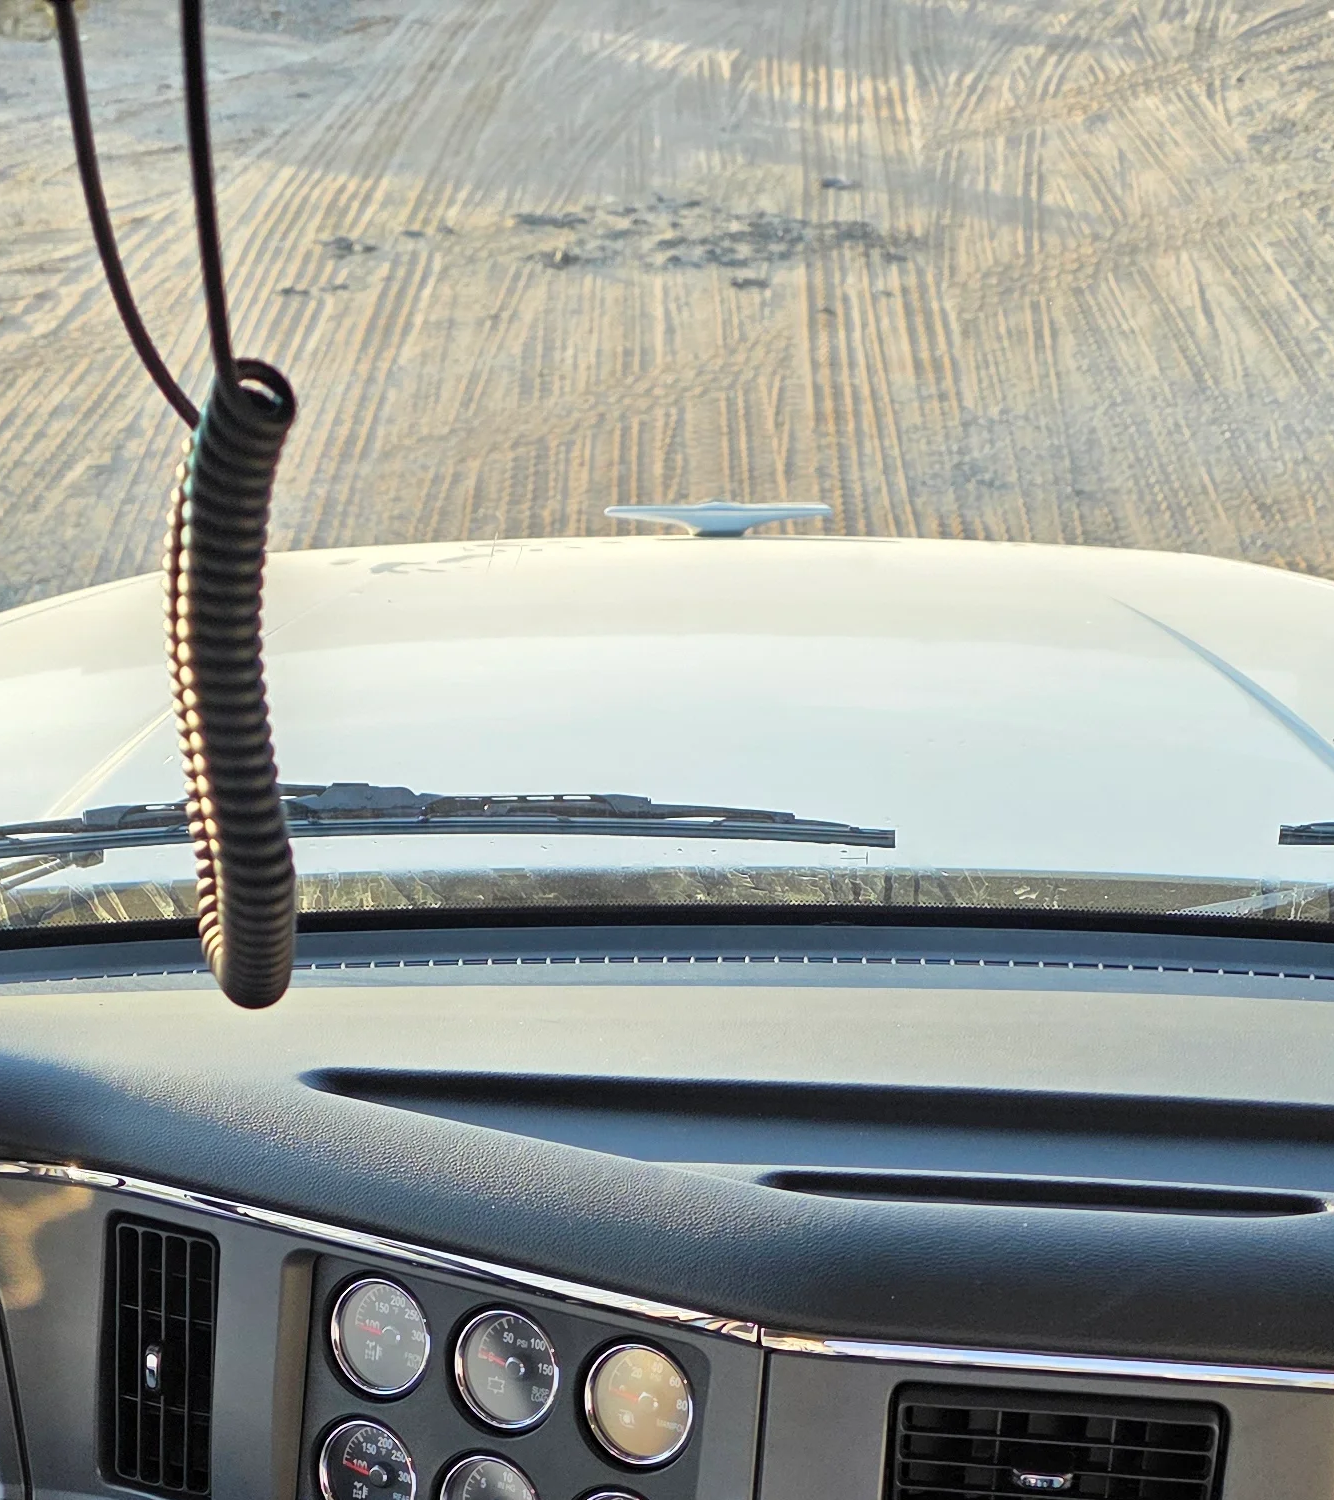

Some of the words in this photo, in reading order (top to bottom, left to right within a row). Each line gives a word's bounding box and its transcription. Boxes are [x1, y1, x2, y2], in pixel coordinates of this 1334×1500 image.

[374, 1302, 389, 1314] 150
[390, 1295, 405, 1308] 200
[404, 1308, 420, 1321] 250
[502, 1331, 514, 1344] 50
[516, 1338, 528, 1348] PSI
[530, 1338, 546, 1351] 100
[537, 1363, 554, 1376] 150
[669, 1376, 681, 1388] 60
[676, 1399, 688, 1411] 80
[362, 1442, 376, 1455] 150
[377, 1436, 393, 1450] 200
[391, 1450, 406, 1463] 250
[480, 1477, 487, 1488] 5
[503, 1471, 513, 1483] 10
